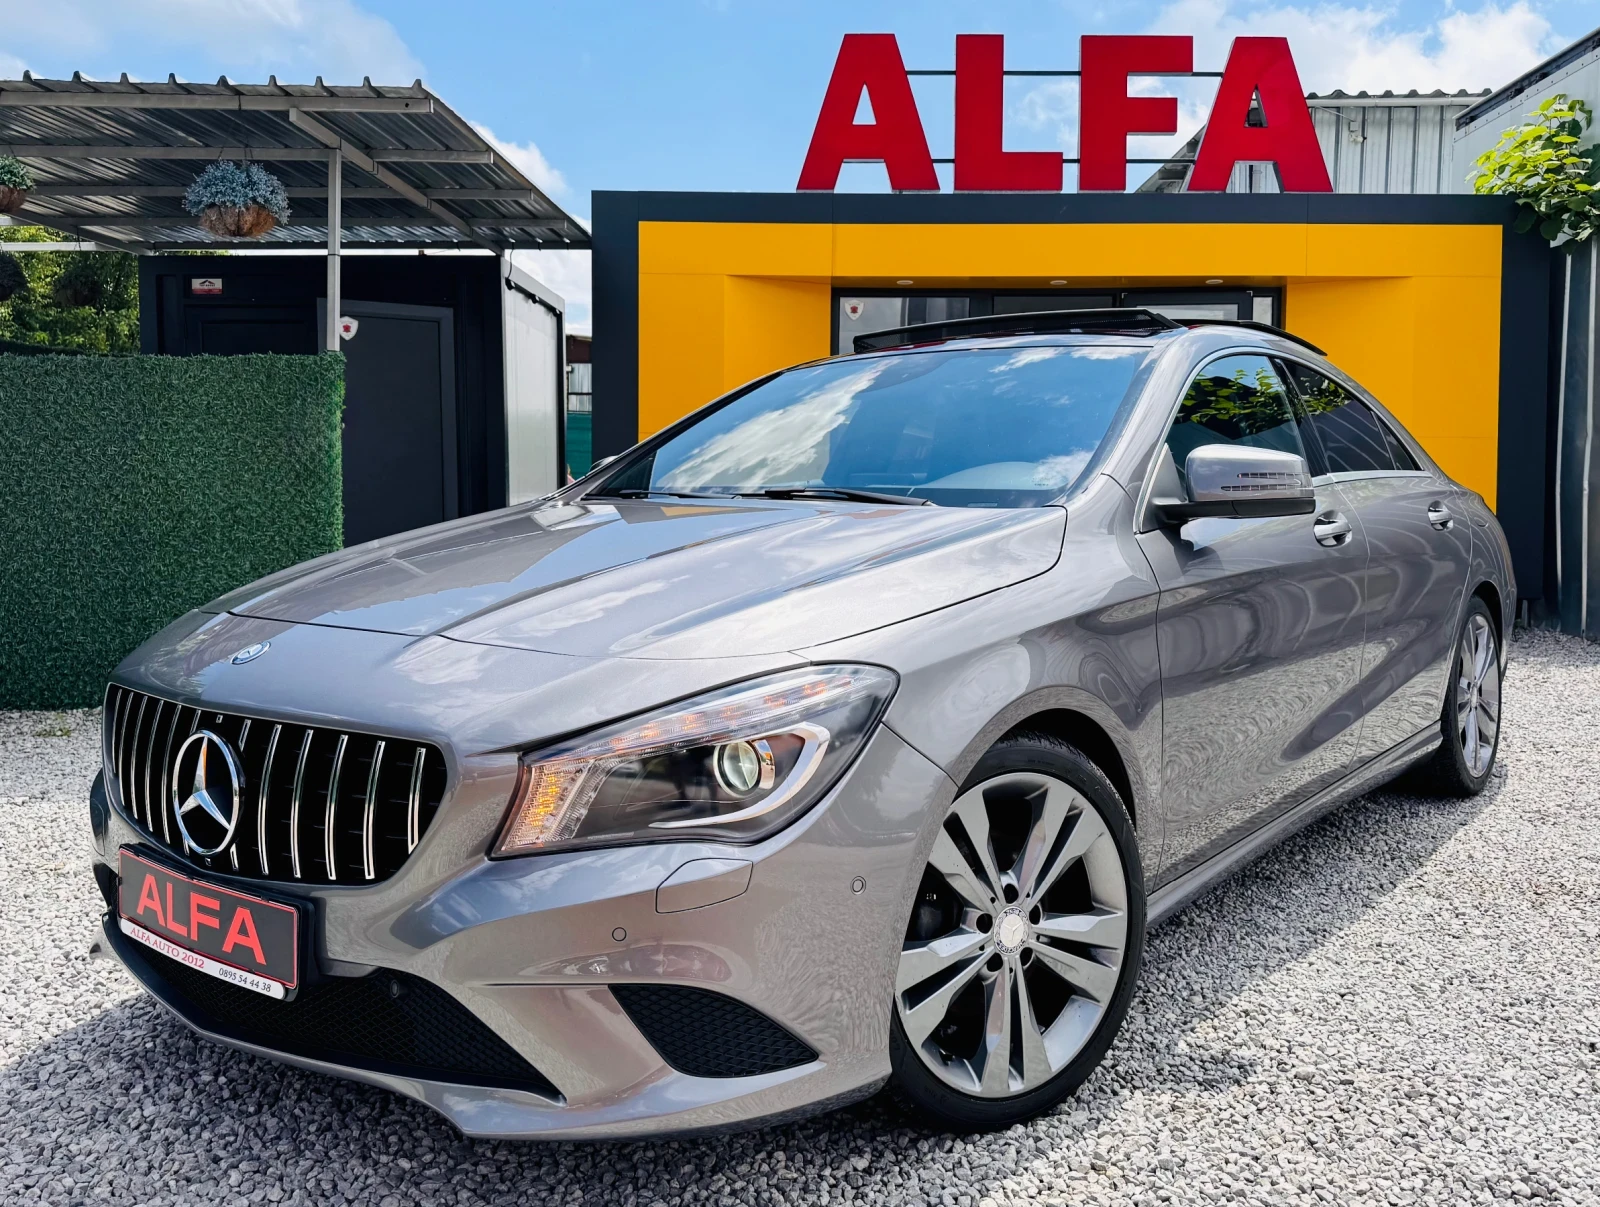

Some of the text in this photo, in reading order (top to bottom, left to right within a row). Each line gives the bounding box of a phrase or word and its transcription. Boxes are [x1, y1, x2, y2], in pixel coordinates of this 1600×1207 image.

[796, 33, 1333, 193] ALFA
[130, 927, 272, 993] ALFA AUTO 2012 0895 54 44 38
[136, 873, 267, 966] ALFA
